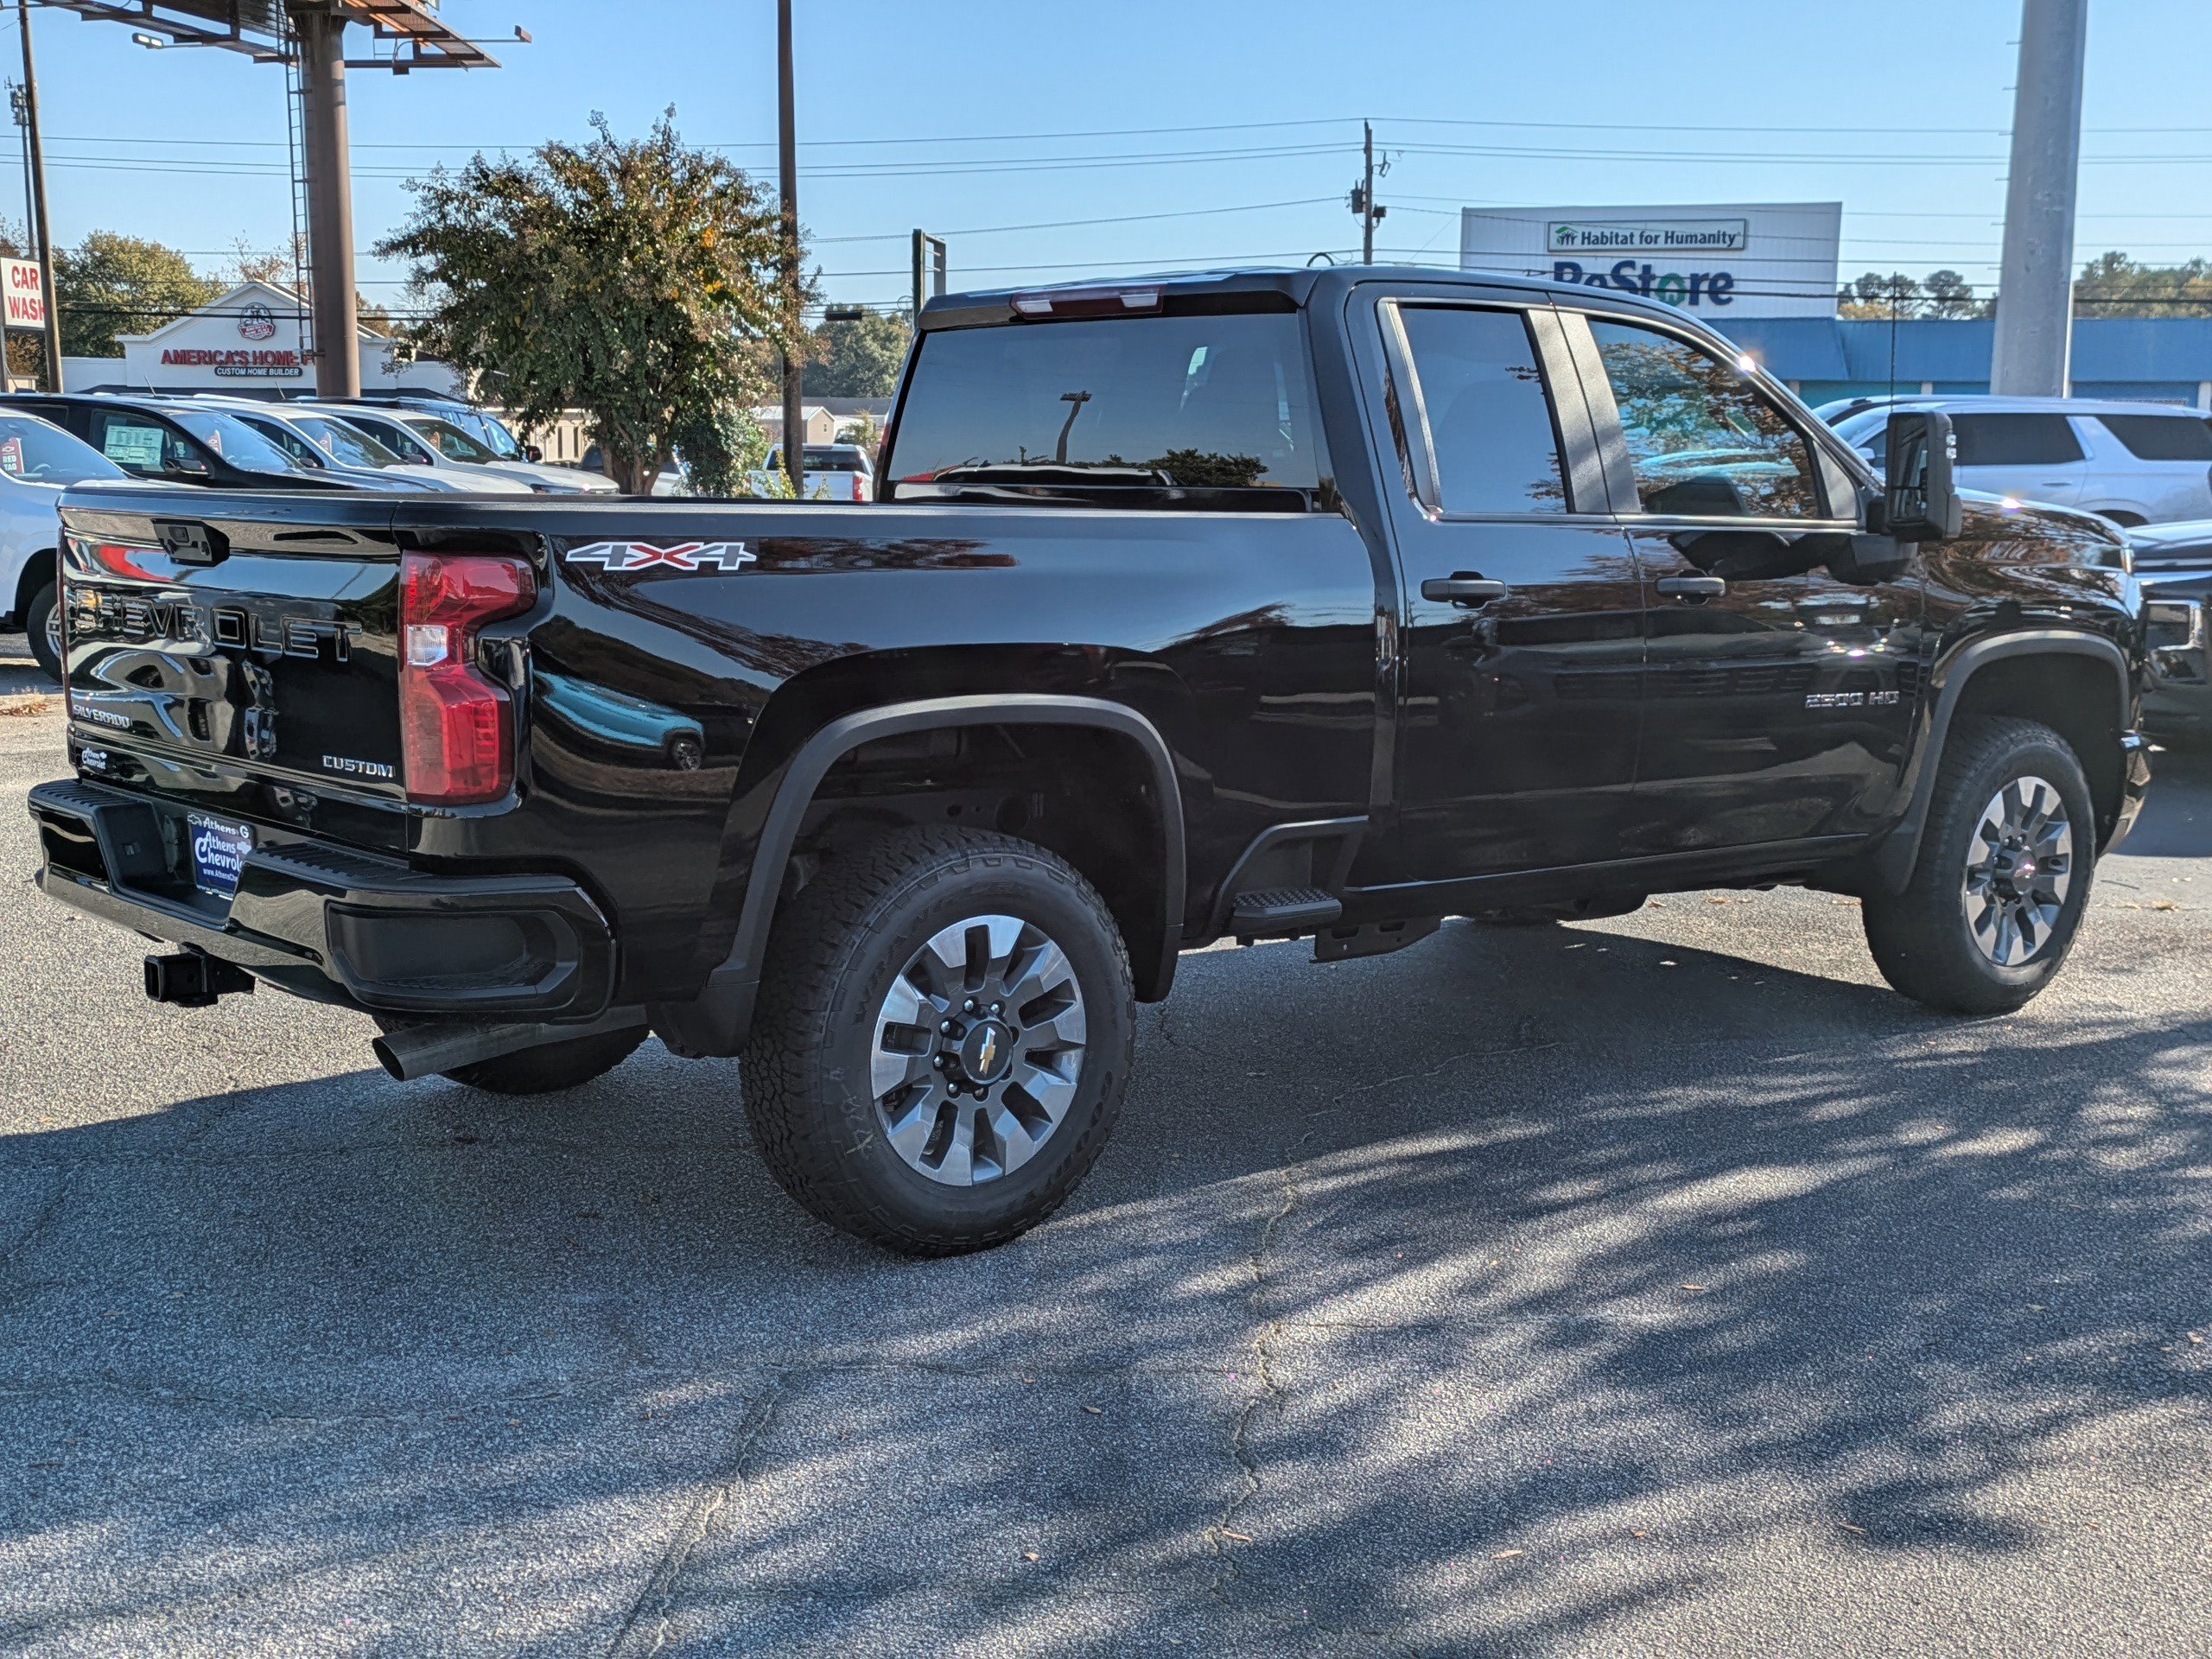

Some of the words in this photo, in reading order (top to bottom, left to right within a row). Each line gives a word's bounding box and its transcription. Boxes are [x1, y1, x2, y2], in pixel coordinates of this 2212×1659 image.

[1580, 230, 1634, 245] Habitat
[1639, 230, 1660, 245] for
[1664, 230, 1737, 247] Humanity
[11, 265, 40, 290] CAR
[161, 349, 250, 366] AMERICA'S
[251, 350, 300, 366] HOME
[216, 367, 246, 376] CUSTOM
[247, 367, 268, 376] HOME
[1805, 692, 1864, 709] 2500
[1868, 691, 1899, 705] HD
[73, 704, 133, 729] SILVERADO
[322, 755, 397, 778] CUSTOM
[205, 830, 236, 855] Athens
